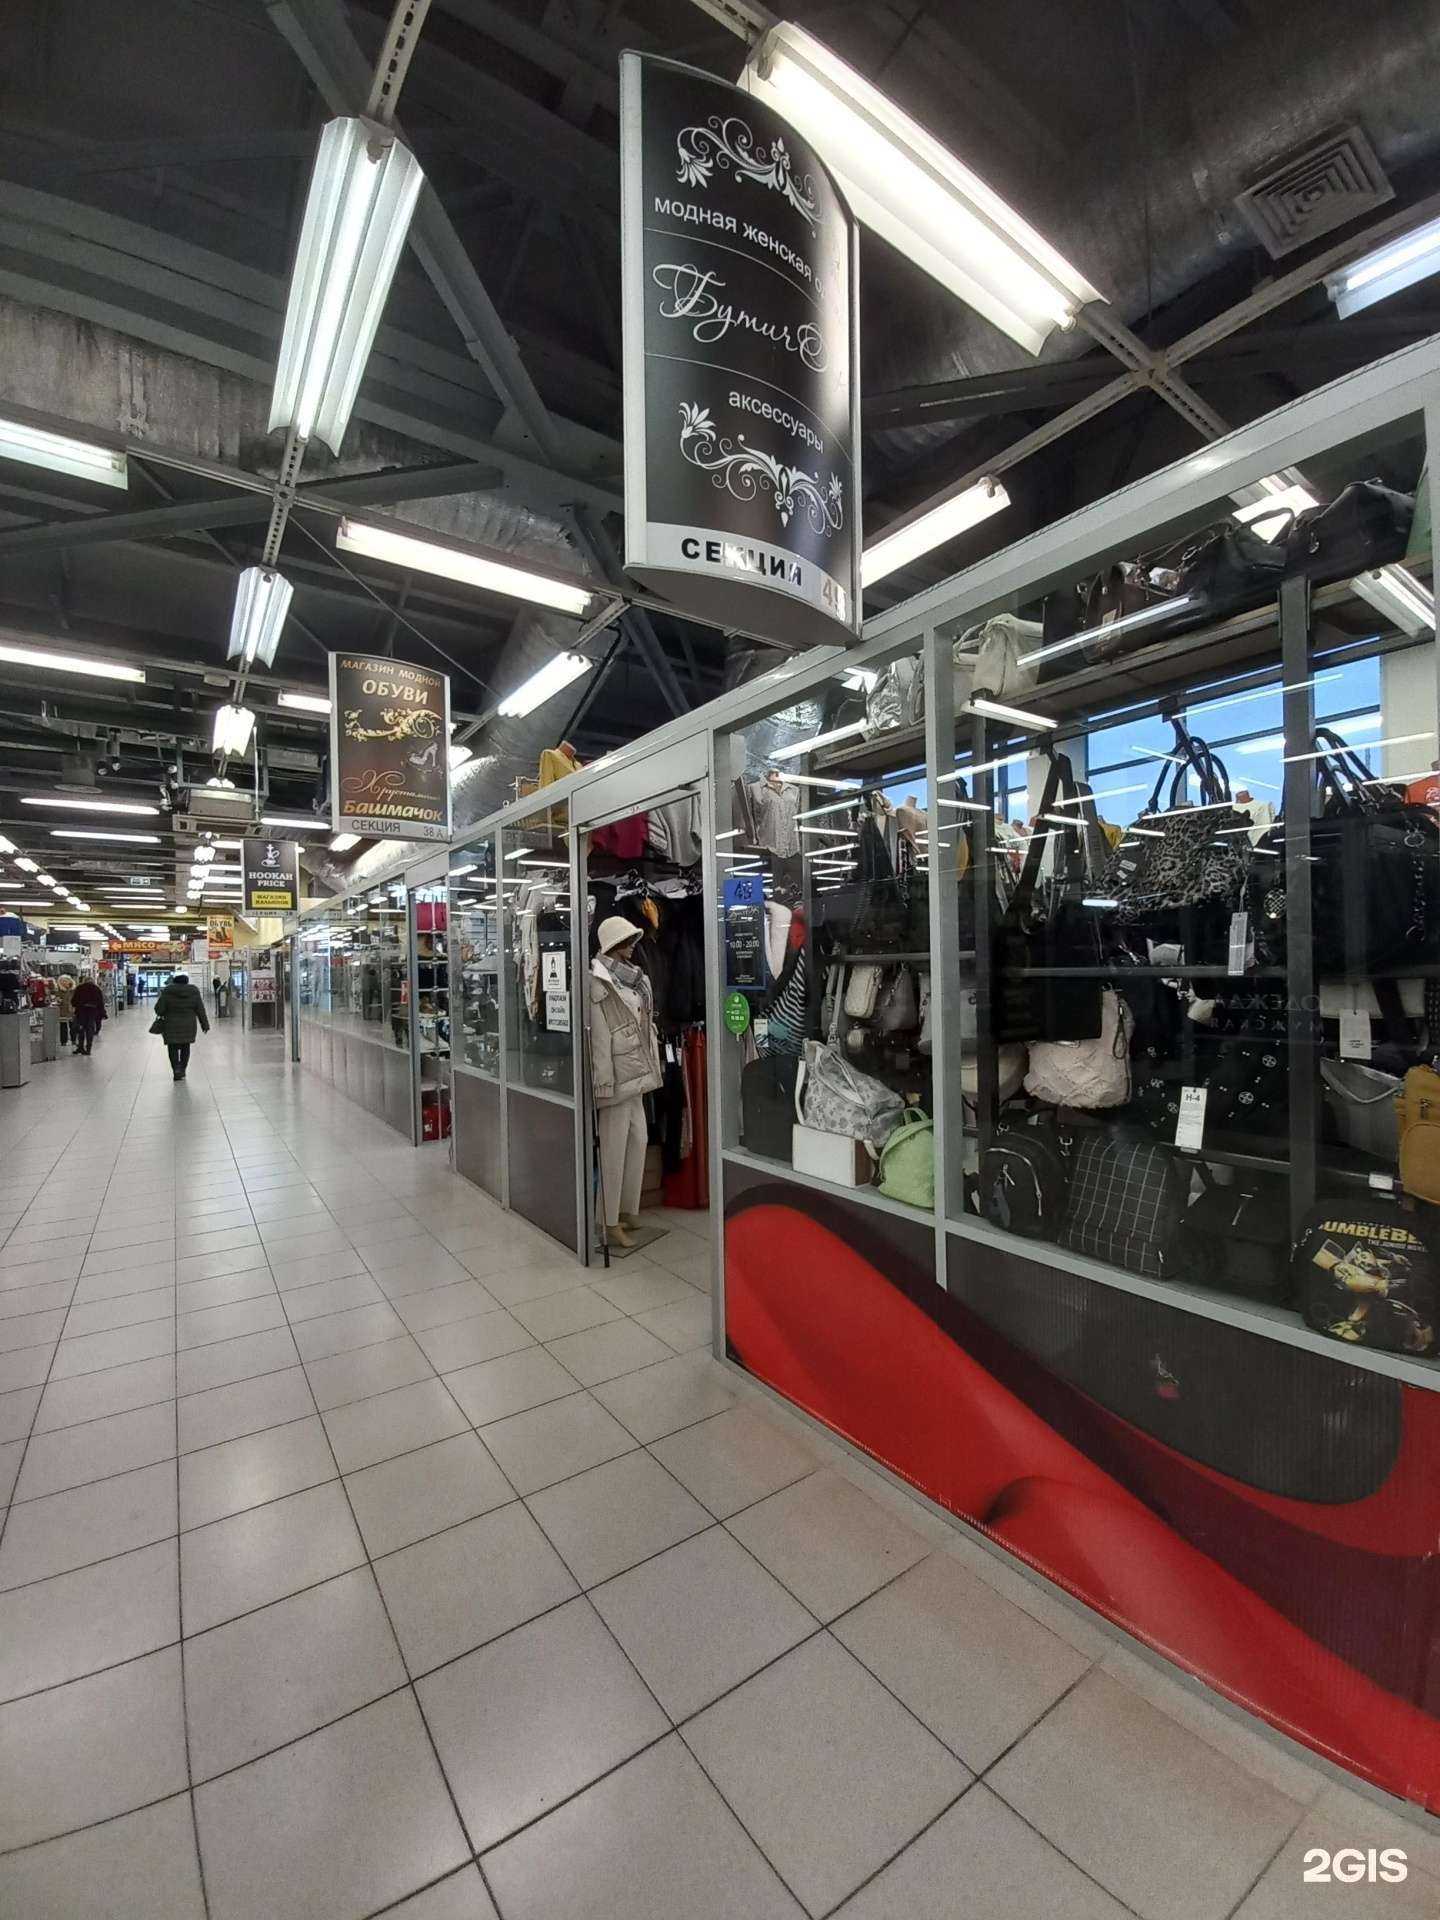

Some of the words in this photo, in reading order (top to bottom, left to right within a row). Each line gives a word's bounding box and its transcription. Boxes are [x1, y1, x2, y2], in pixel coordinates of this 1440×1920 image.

[654, 197, 738, 234] модная
[742, 223, 812, 282] женская
[728, 391, 824, 454] аксессуары
[822, 578, 847, 622] 4
[341, 660, 394, 675] МАГАЗИН
[362, 679, 429, 704] ОБУВИ
[343, 800, 443, 822] Башмачок
[352, 819, 401, 834] СЕКЦИЯ
[248, 871, 293, 881] HOOKAH
[257, 880, 286, 888] PRICE
